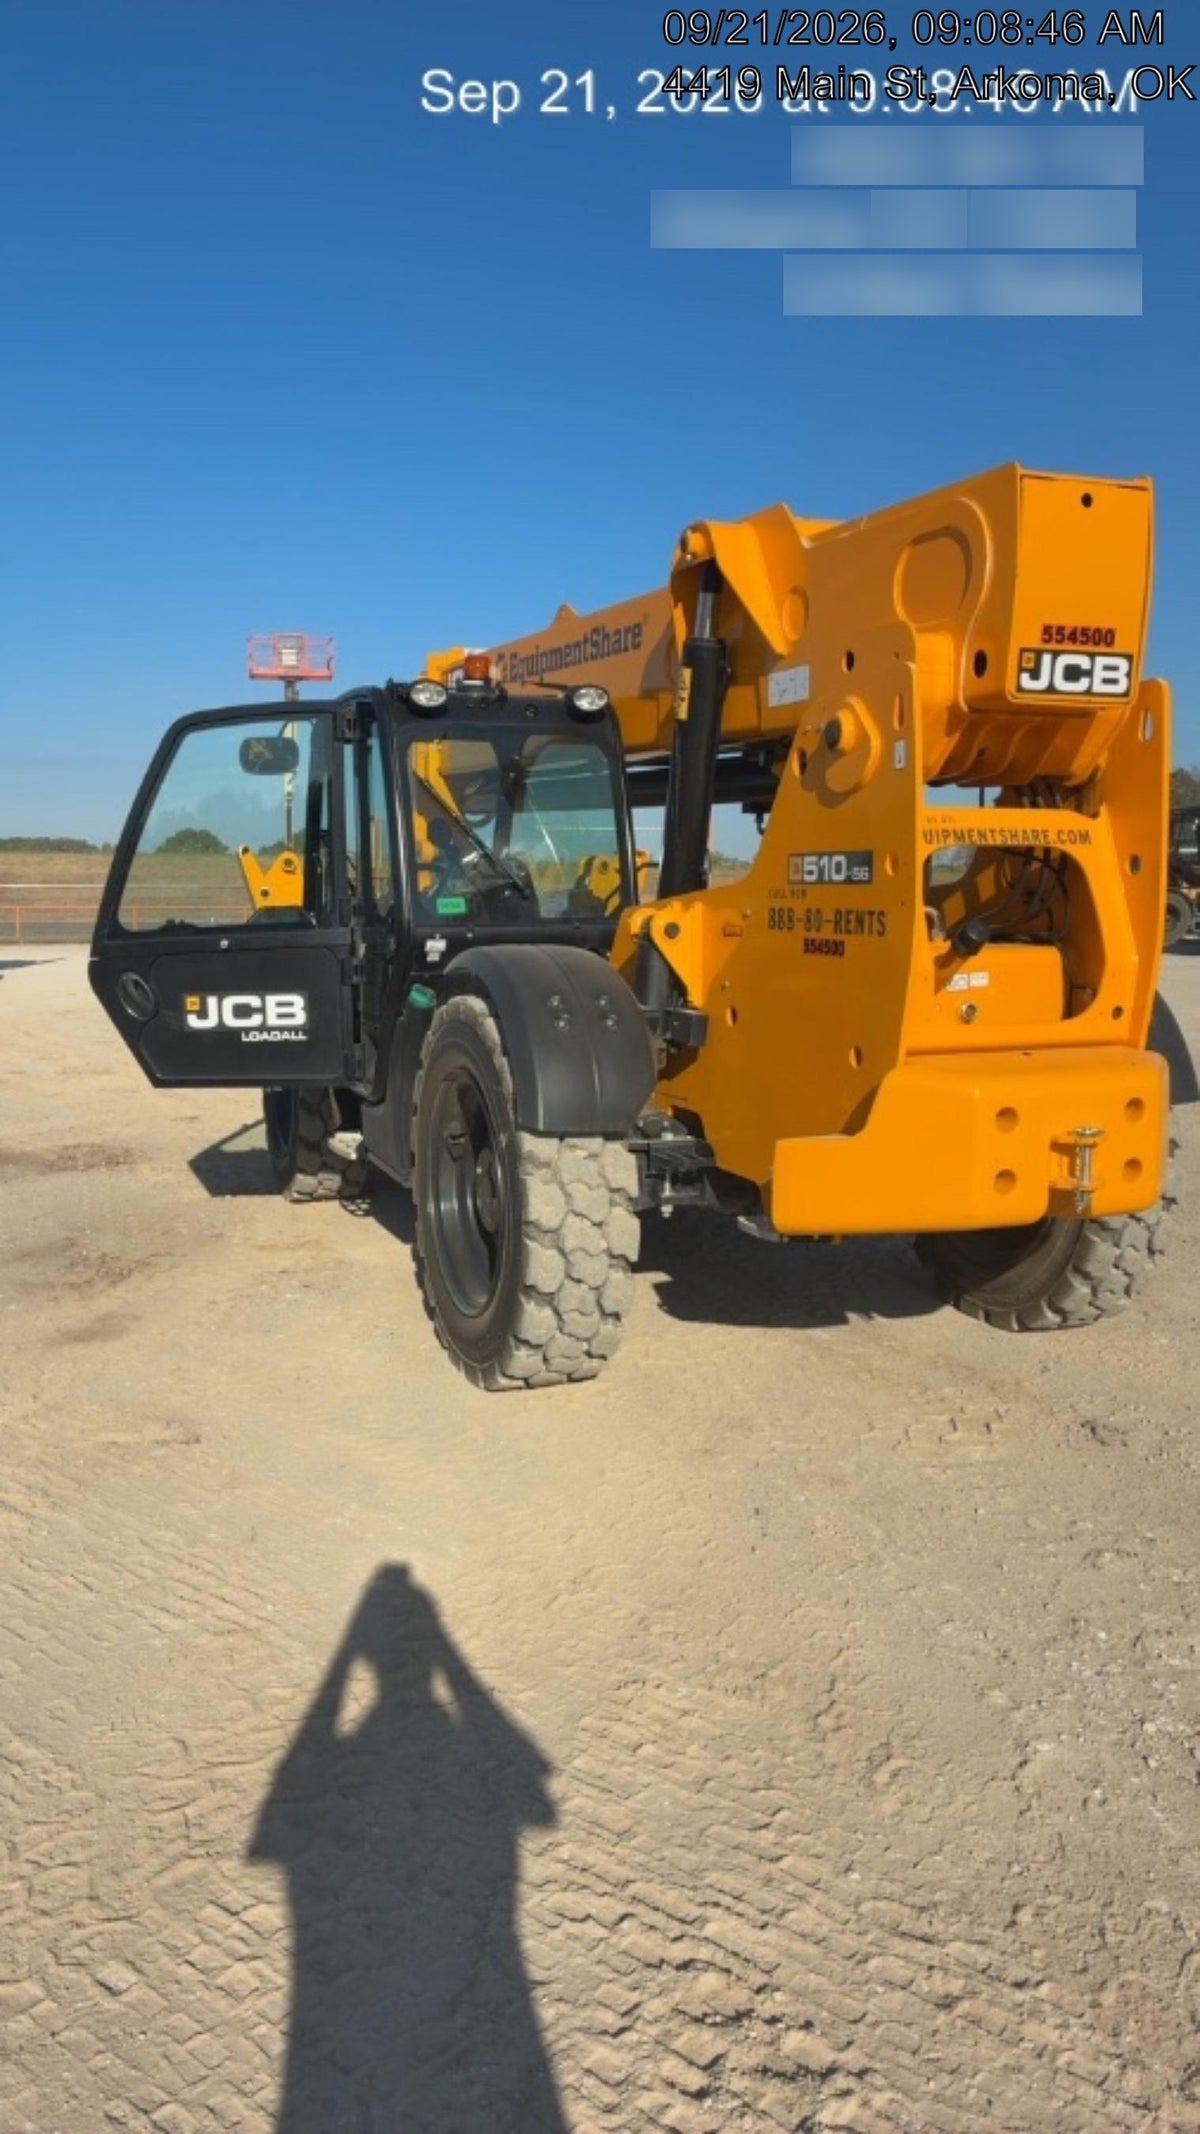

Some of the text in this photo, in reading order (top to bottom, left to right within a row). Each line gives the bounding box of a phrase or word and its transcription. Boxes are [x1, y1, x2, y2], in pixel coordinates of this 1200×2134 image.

[1041, 625, 1115, 646] 554500
[509, 621, 644, 684] EquipmentShare
[1019, 651, 1130, 694] JCB
[768, 907, 887, 937] 888-80-RENTS
[187, 993, 307, 1028] JCB
[241, 1031, 308, 1042] LOADALL
